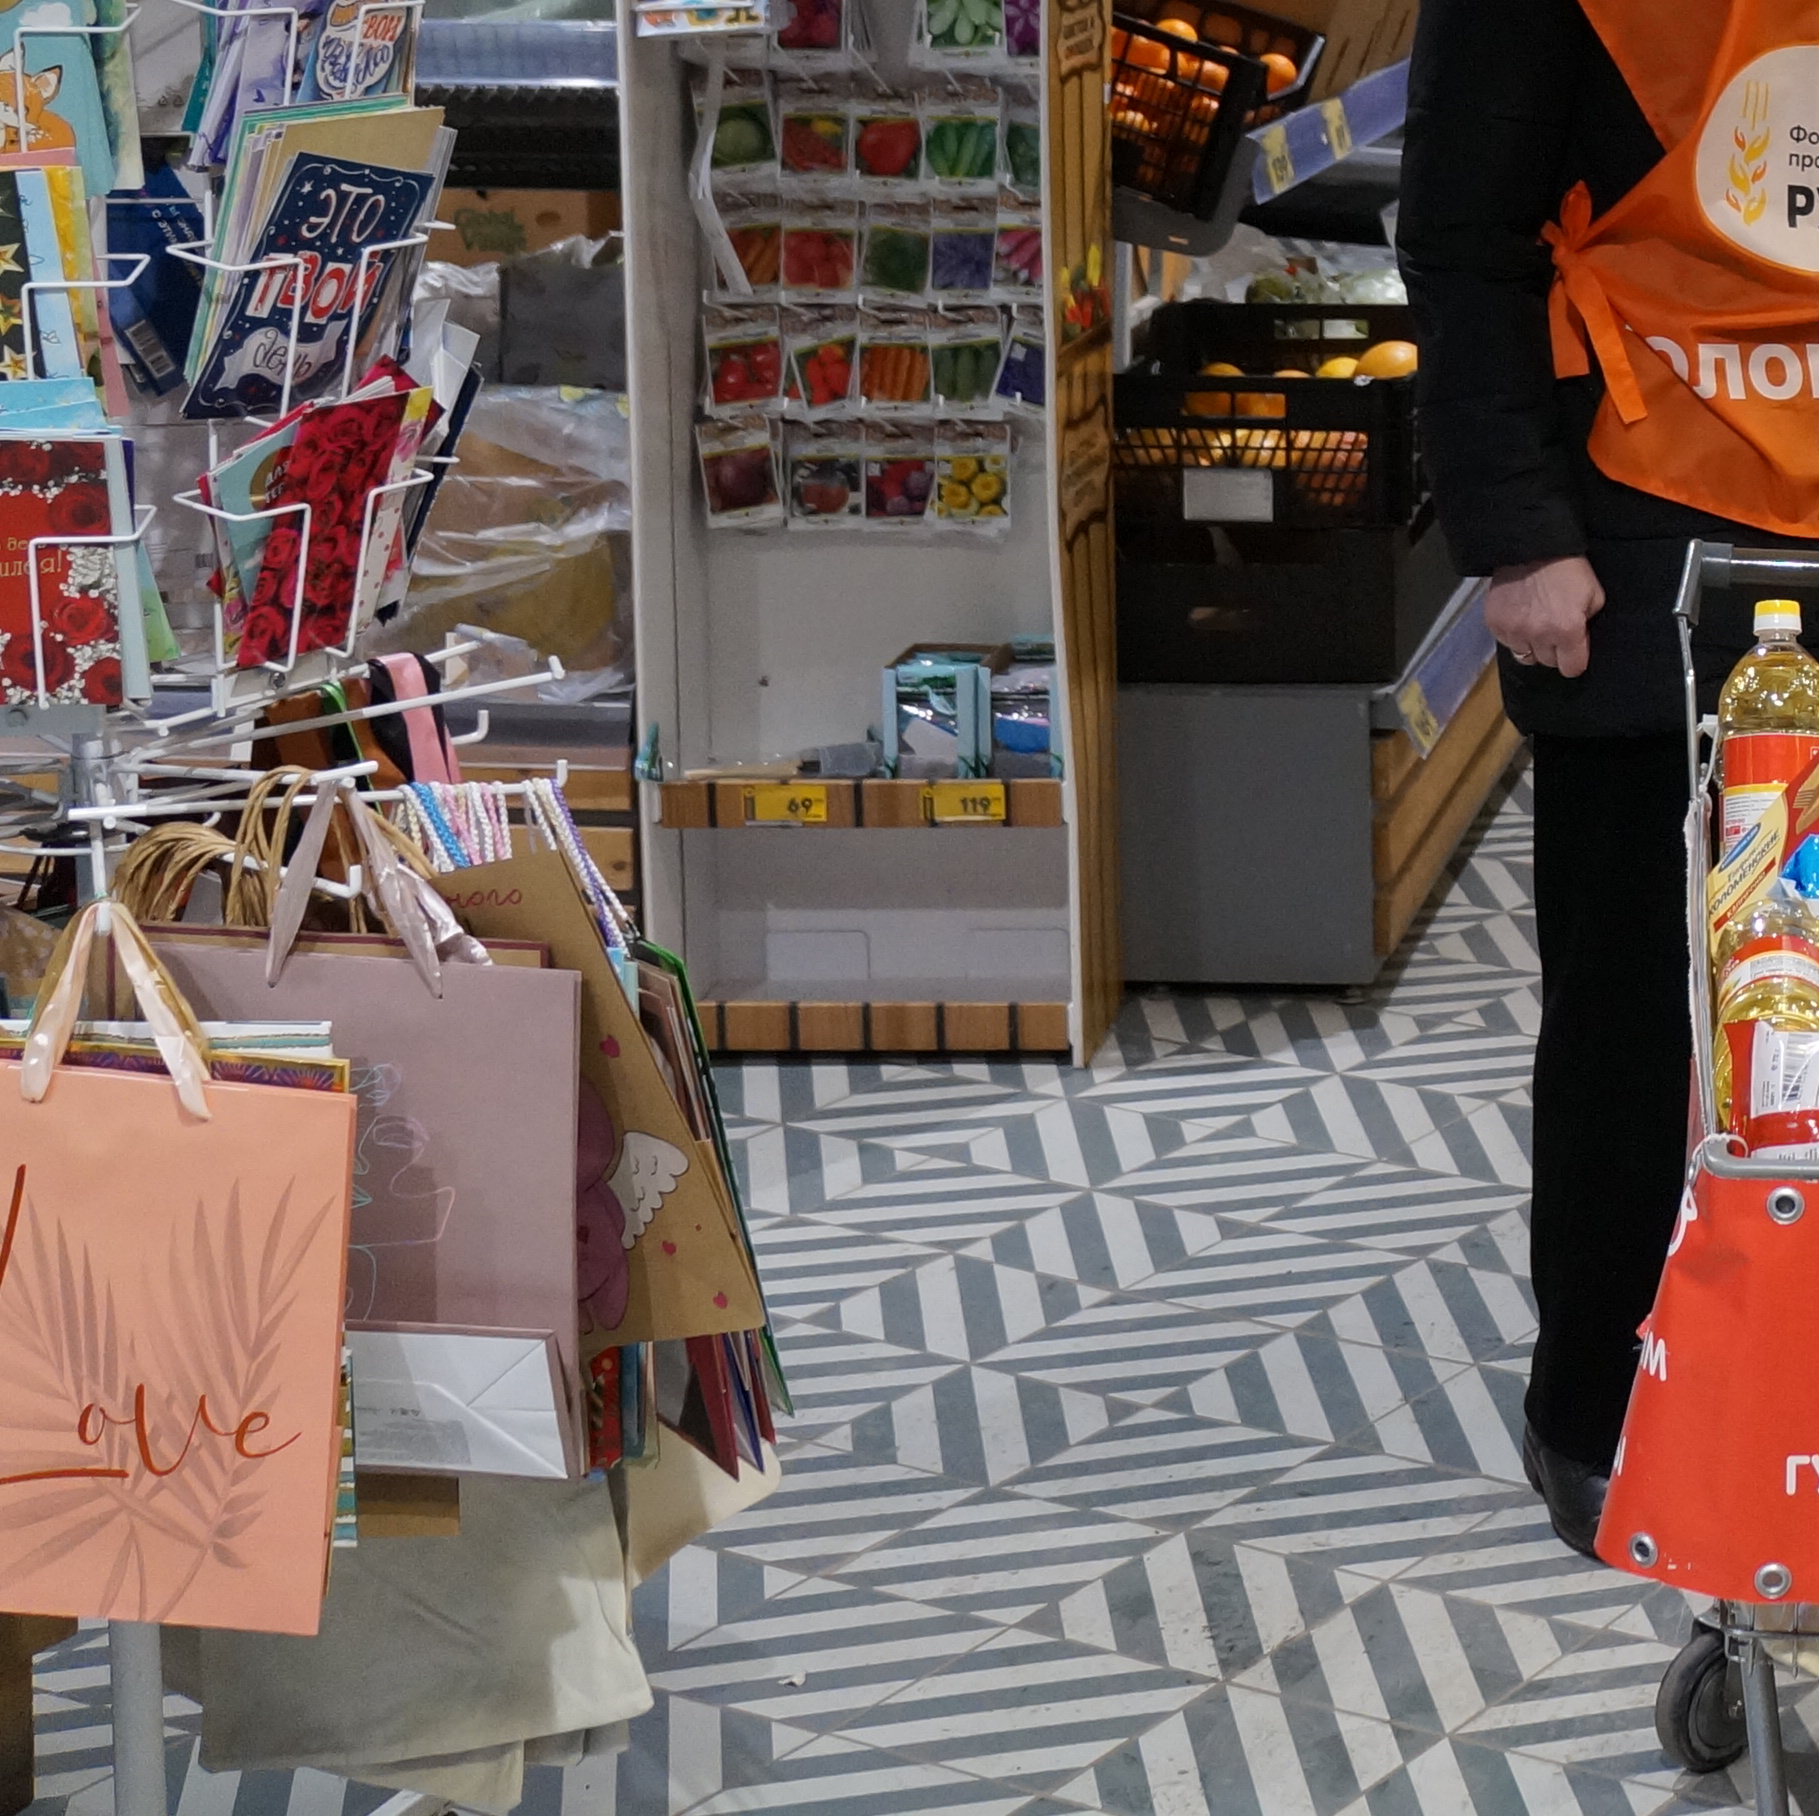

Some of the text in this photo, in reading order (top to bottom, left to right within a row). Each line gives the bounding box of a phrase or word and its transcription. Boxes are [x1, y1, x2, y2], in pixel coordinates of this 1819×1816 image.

[300, 182, 388, 246] ЭТО
[786, 795, 814, 814] 69
[959, 795, 991, 814] 119
